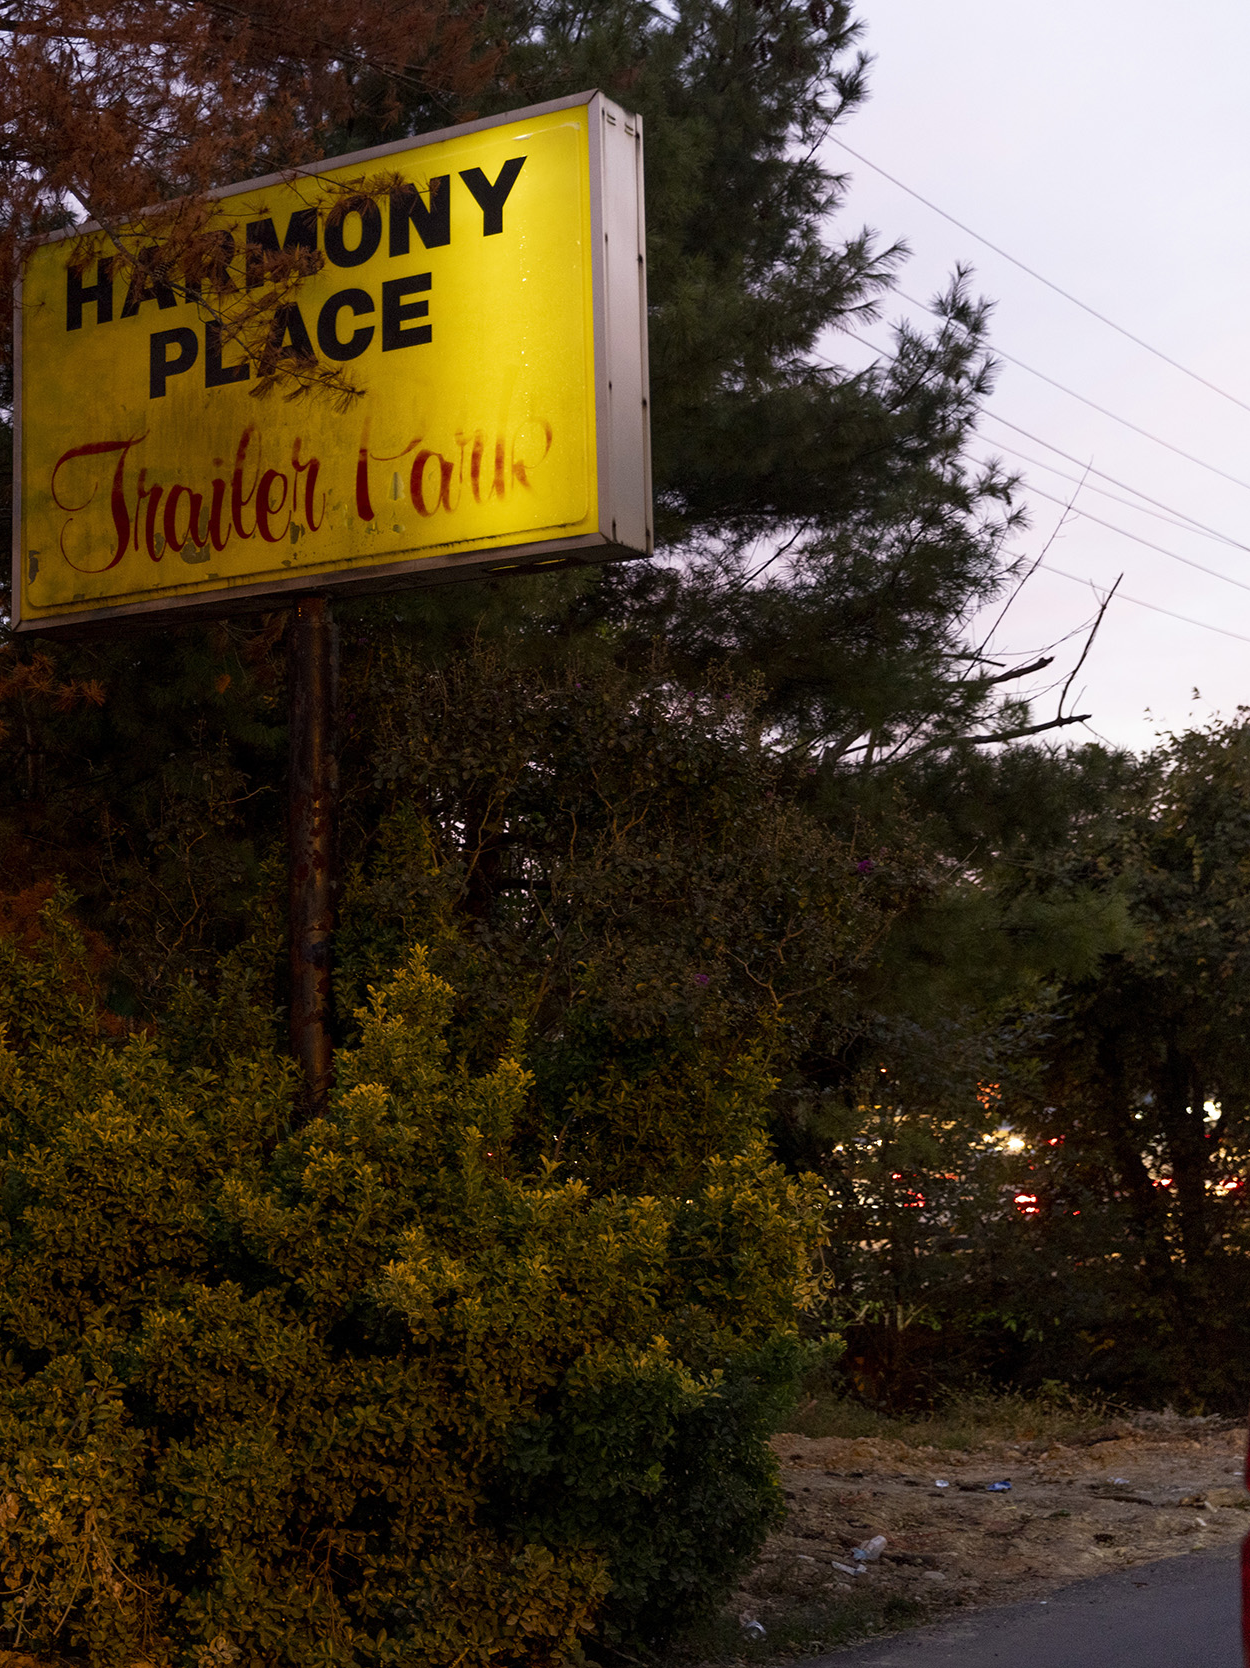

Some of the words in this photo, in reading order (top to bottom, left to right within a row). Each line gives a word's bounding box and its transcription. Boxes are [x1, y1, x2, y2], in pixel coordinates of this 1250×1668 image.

[66, 156, 527, 332] HARMONY
[150, 273, 432, 399] PLACE
[51, 423, 327, 574] Trailer
